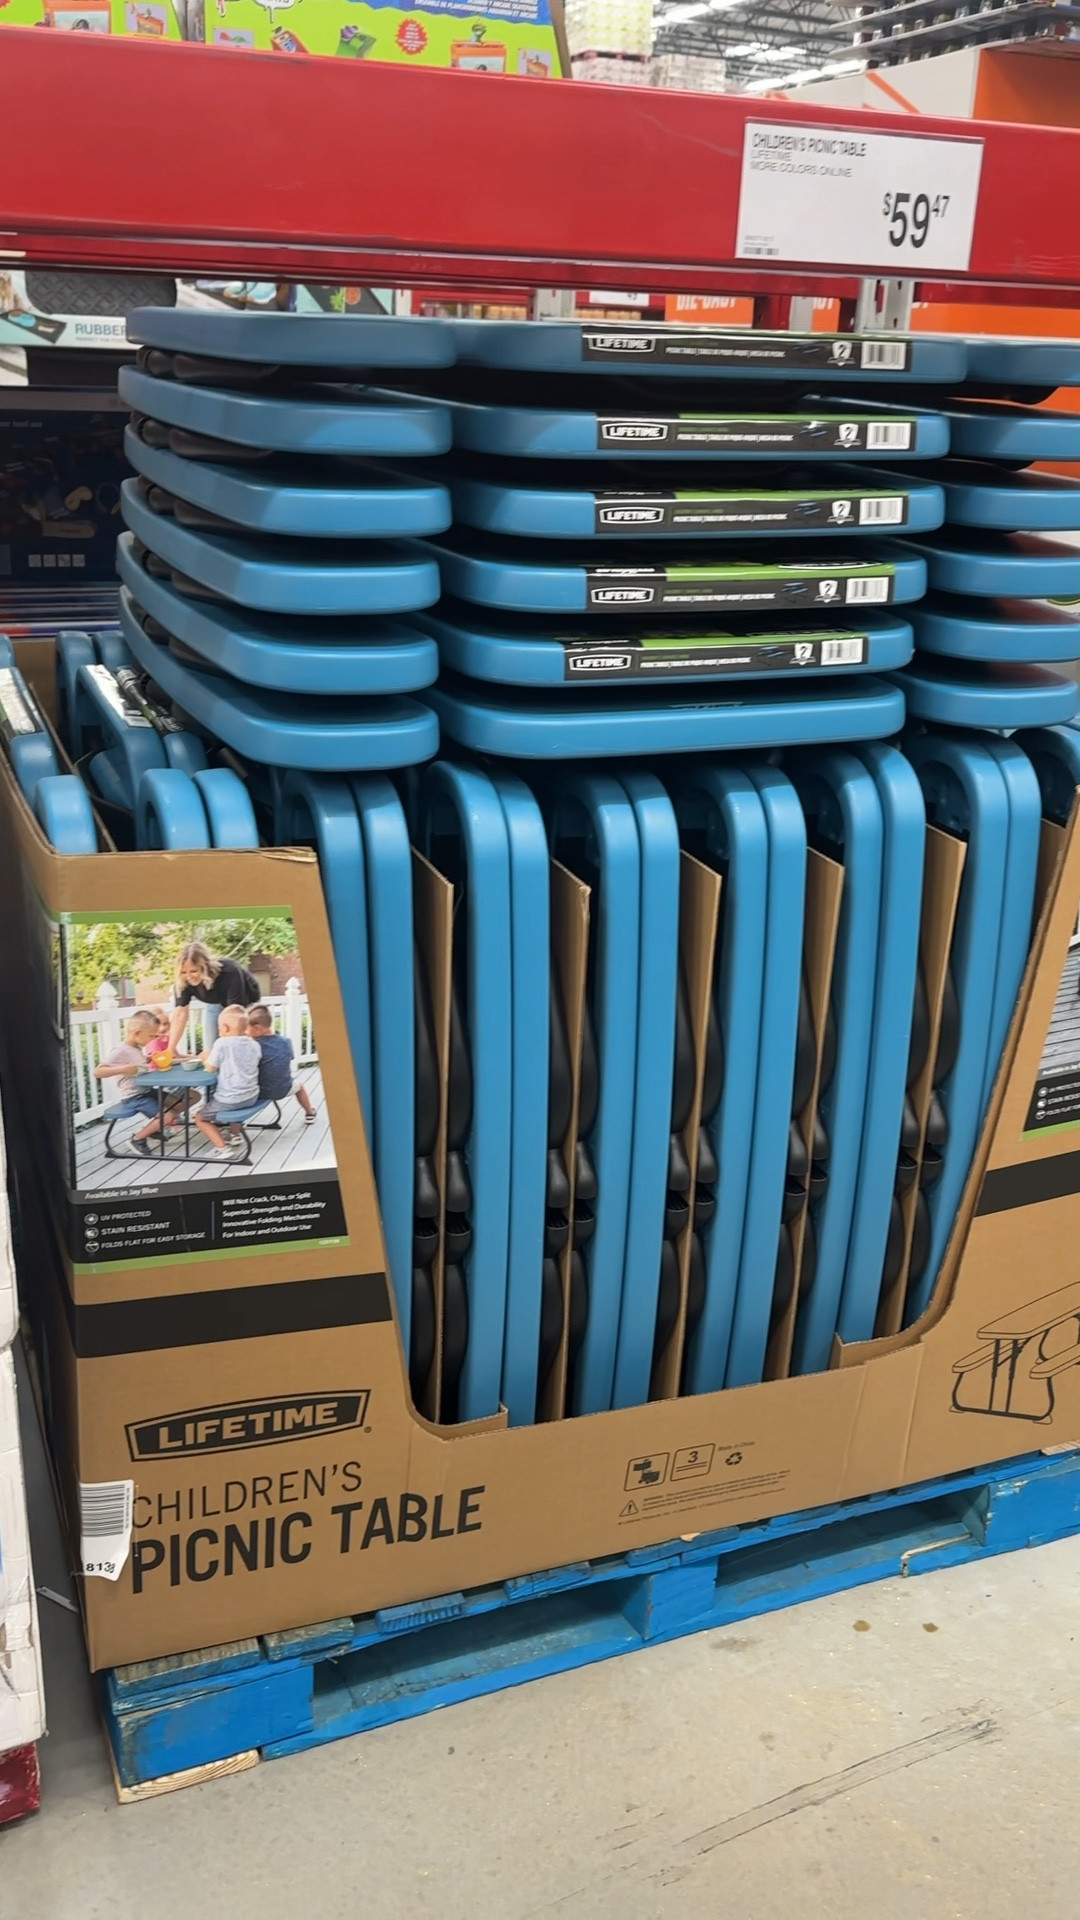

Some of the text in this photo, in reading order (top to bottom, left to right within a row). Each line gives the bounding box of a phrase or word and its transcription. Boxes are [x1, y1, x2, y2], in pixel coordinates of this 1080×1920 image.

[752, 133, 867, 157] CHILDREN'S PICNIC TABLE
[750, 160, 853, 178] MORE COLORS ONLINE
[596, 337, 647, 350] LIFETIME
[609, 426, 660, 438] LIFETIME
[607, 509, 656, 522] LIFETIME
[598, 589, 647, 601] LIFETIME
[576, 656, 624, 669] LIFETIME
[111, 1210, 152, 1220] PROTECTED
[101, 1221, 171, 1236] STAIN RESISTANT
[256, 1227, 270, 1235] and
[101, 1240, 123, 1249] FOLDS
[124, 1238, 141, 1247] FLAT
[142, 1237, 156, 1245] FOR
[175, 1231, 206, 1241] STORAGE
[158, 1401, 339, 1450] LIFETIME
[687, 1450, 699, 1464] 3
[132, 1460, 363, 1529] CHILDREN'S
[132, 1485, 487, 1595] PICNIC TABLE
